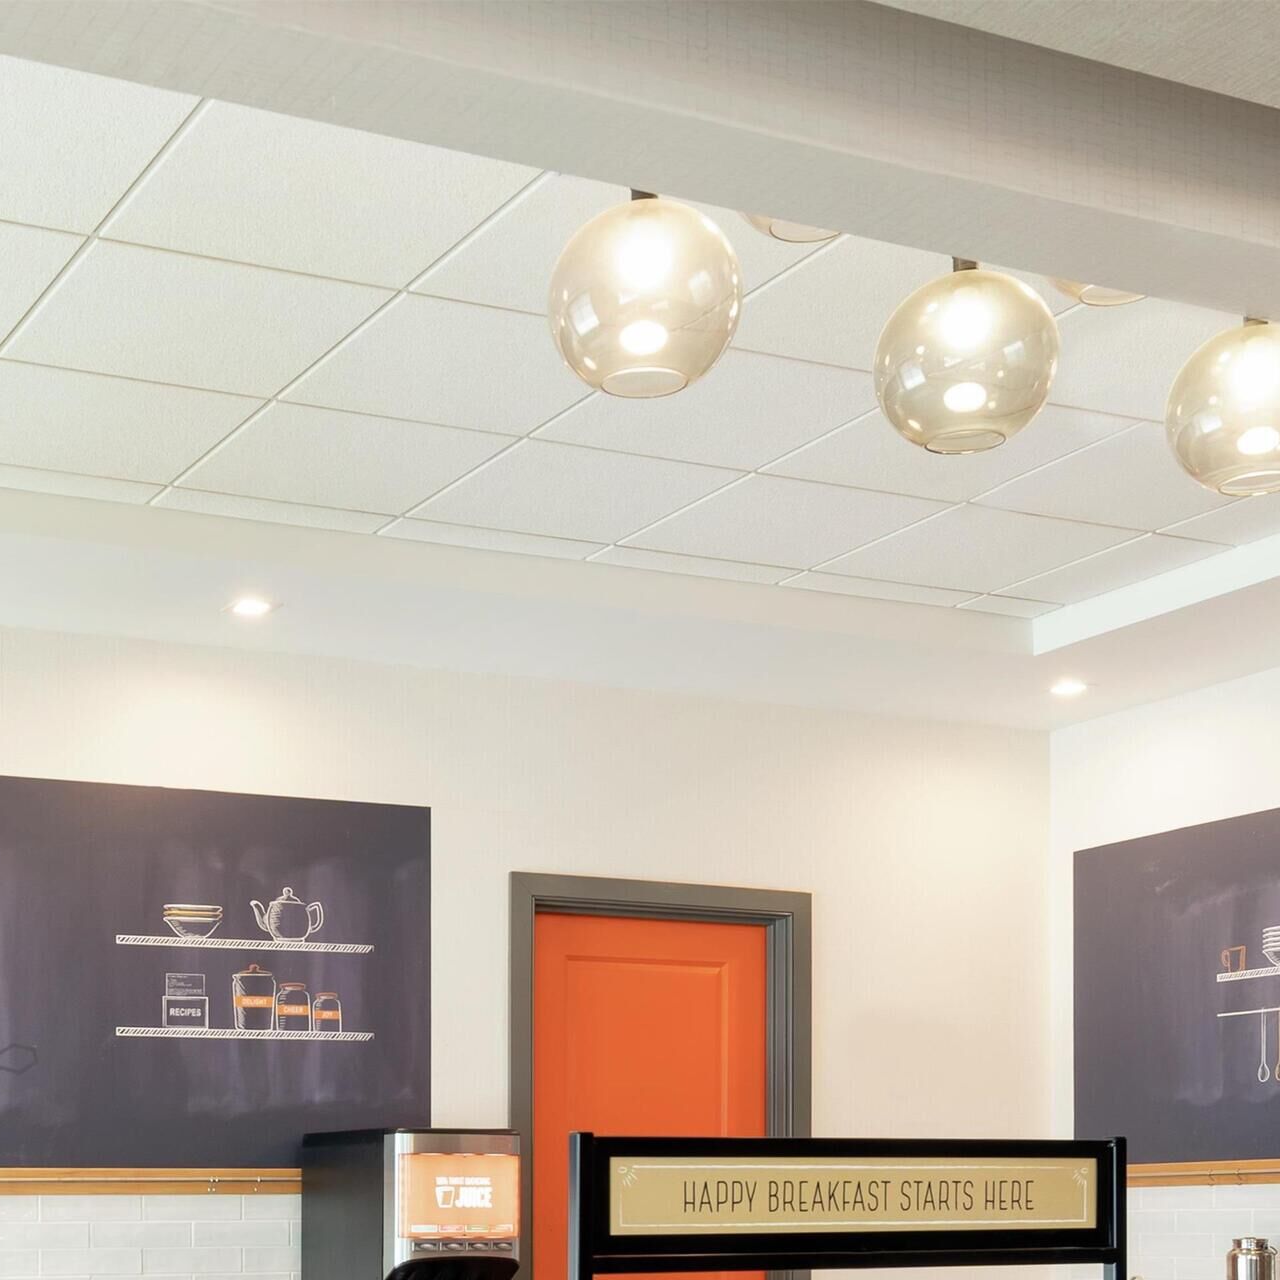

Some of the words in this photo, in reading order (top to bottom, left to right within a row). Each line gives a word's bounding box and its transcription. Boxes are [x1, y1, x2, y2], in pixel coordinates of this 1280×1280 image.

[169, 1007, 201, 1017] RECIPES
[683, 1180, 758, 1213] HAPPY
[768, 1180, 891, 1213] BREAKFAST
[900, 1180, 974, 1212] STARTS
[984, 1179, 1035, 1211] HERE
